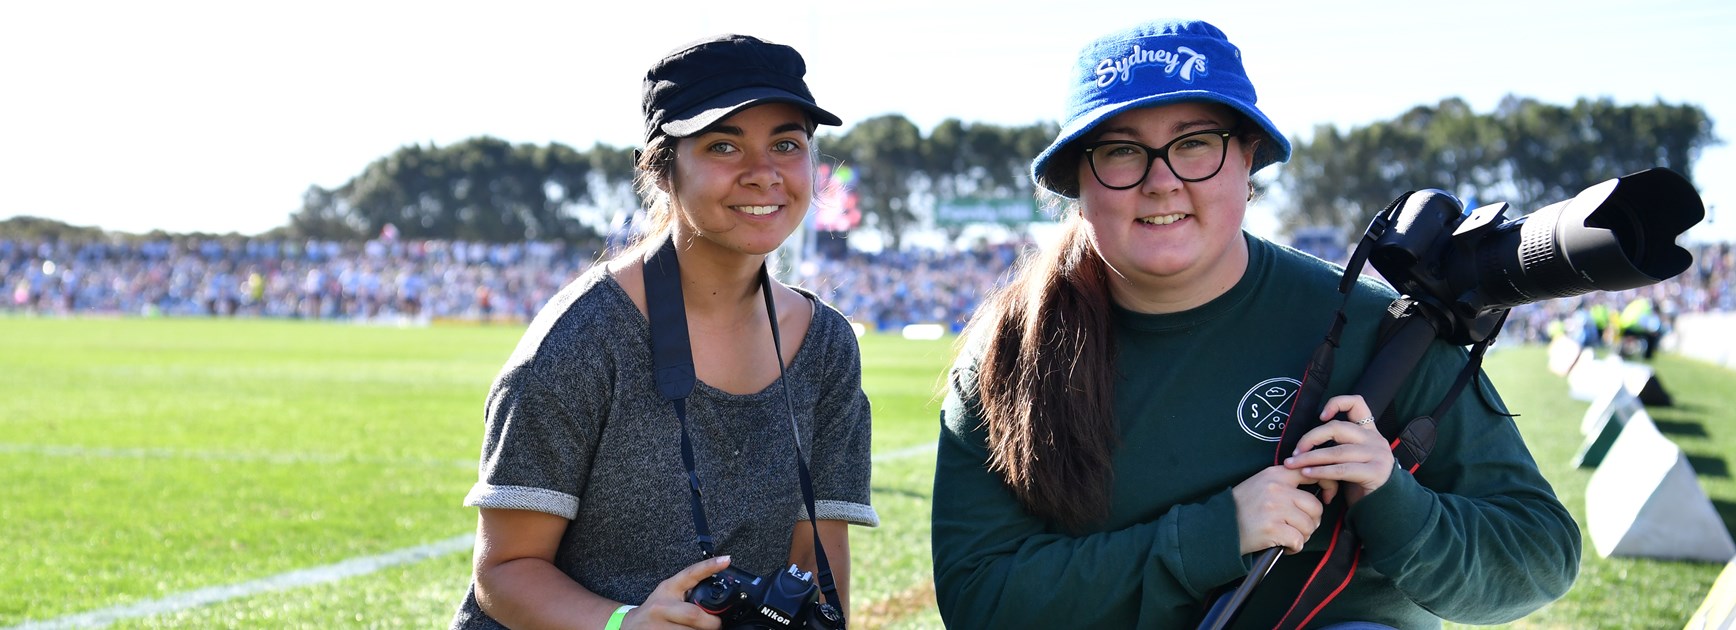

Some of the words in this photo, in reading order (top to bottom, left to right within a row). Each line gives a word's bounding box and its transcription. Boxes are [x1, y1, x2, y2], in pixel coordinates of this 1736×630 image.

[1096, 45, 1180, 88] Sydney
[1177, 46, 1206, 81] 7s
[1251, 403, 1259, 418] S
[760, 606, 791, 626] Nikon
